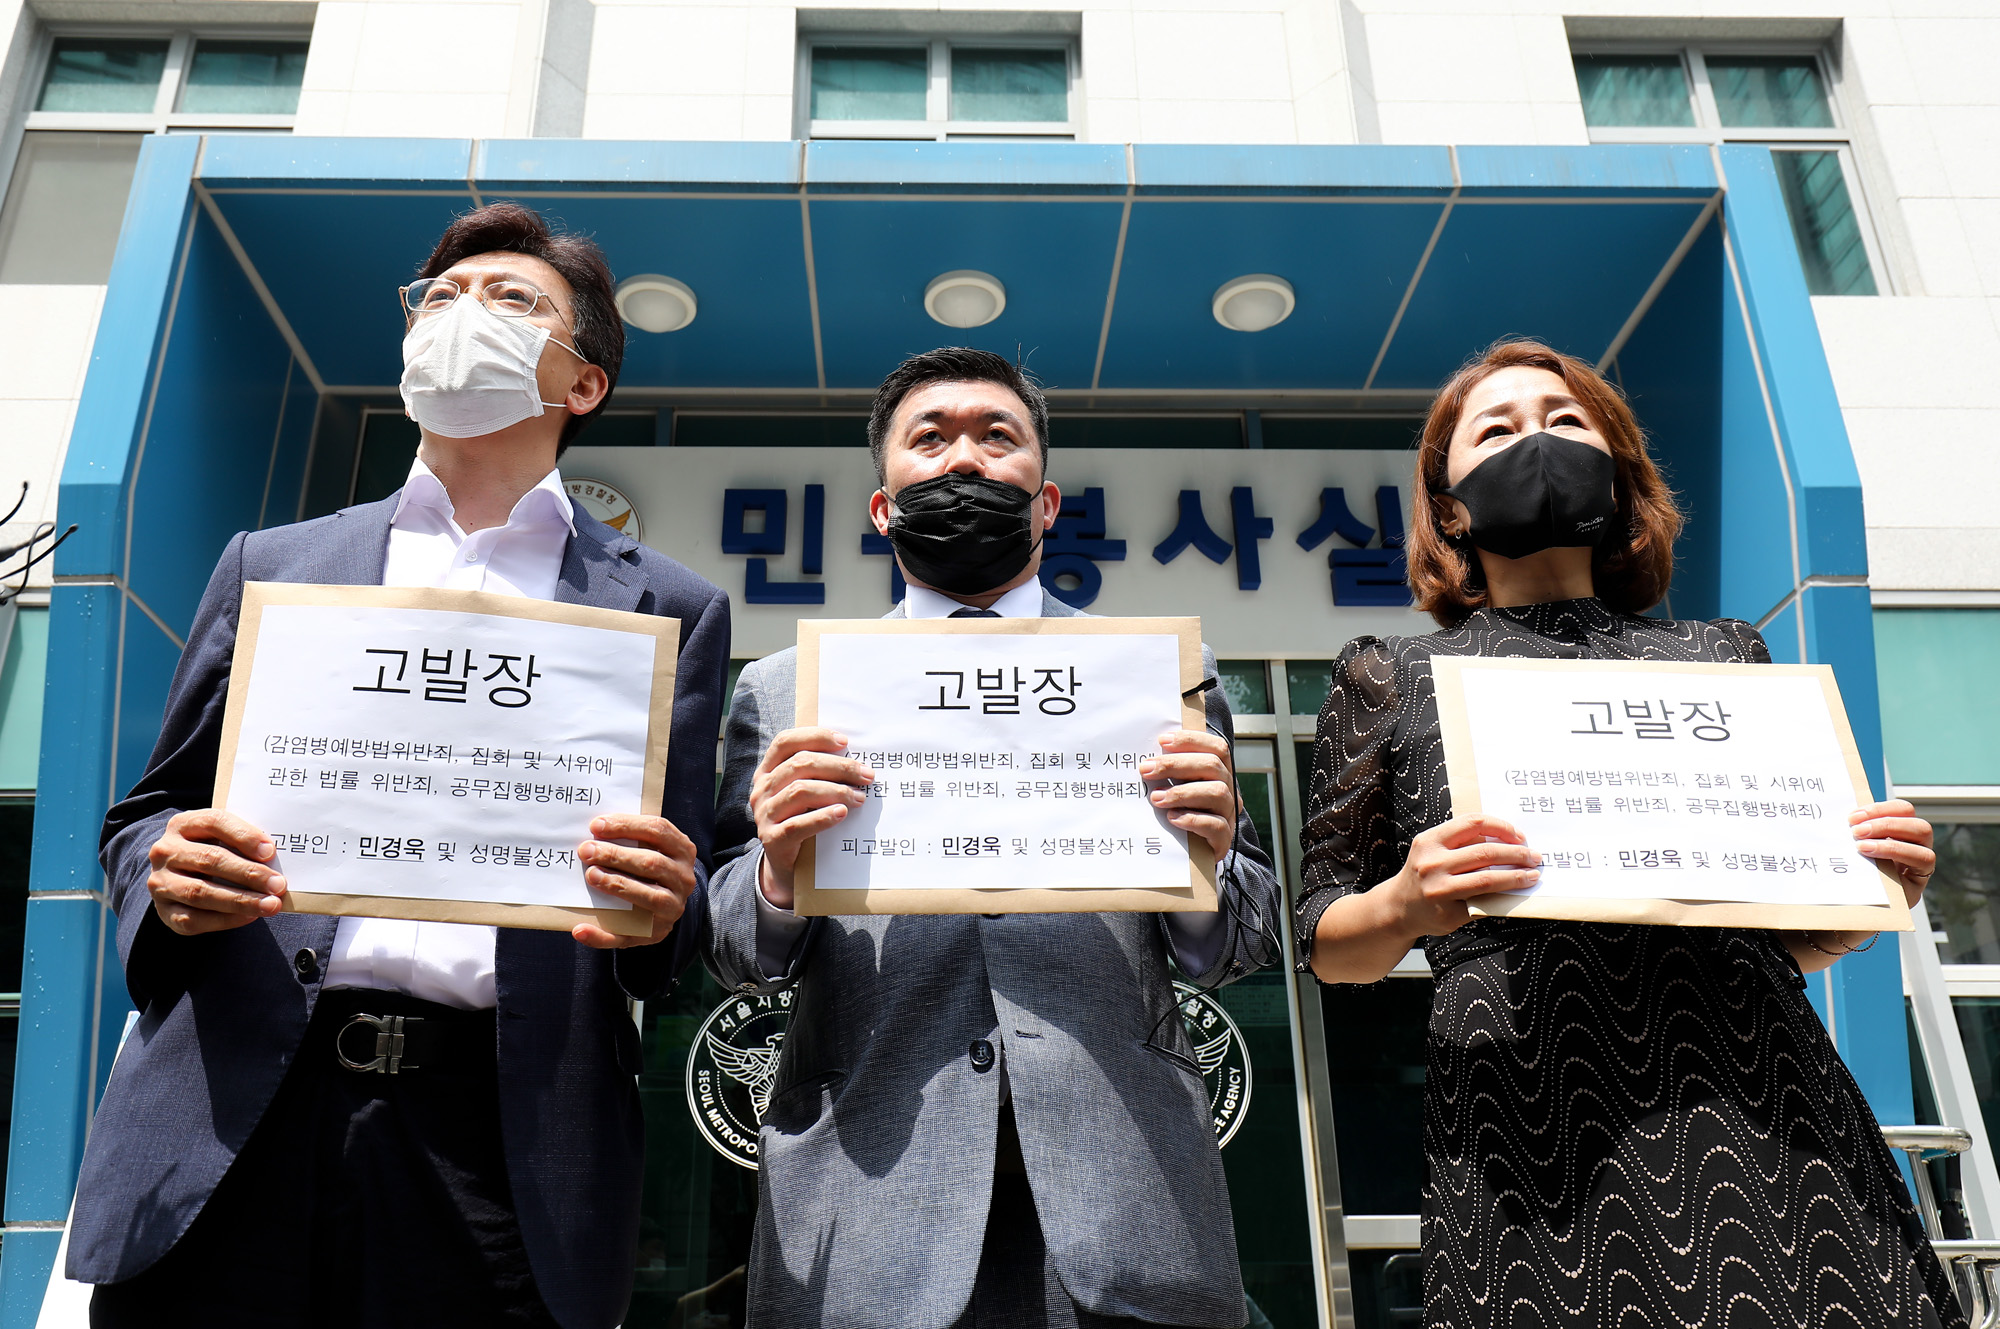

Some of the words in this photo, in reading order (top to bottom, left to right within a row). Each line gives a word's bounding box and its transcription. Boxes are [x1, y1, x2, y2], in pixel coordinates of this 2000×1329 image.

[565, 484, 617, 505] 방경찰청
[721, 484, 1414, 610] 민봉사실
[353, 647, 542, 709] 고발장
[918, 665, 1083, 717] 고발장
[1570, 699, 1732, 743] 고발장
[264, 734, 459, 763] (감염병예방법위반죄,
[471, 747, 511, 768] 집회
[523, 751, 542, 770] 및
[553, 753, 613, 777] 시위에
[1030, 752, 1065, 770] 집회
[1075, 752, 1092, 770] 및
[268, 767, 308, 788] 관한
[320, 769, 360, 790] 법률
[371, 772, 438, 795] 위반죄,
[450, 777, 602, 806] 공무집행방해죄)
[900, 780, 936, 798] 법률
[945, 780, 1005, 798] 위반죄,
[1015, 781, 1149, 799] 공무집행방해죄)
[1694, 773, 1731, 789] 집회
[1740, 774, 1759, 791] 및
[1770, 776, 1825, 793] 시위에
[1519, 796, 1555, 813] 관한
[1565, 796, 1603, 814] 법률
[1685, 797, 1823, 820] 공무집행방해죄)
[268, 833, 330, 855] 고발인
[357, 836, 427, 860] 민경욱
[437, 841, 457, 862] 및
[469, 843, 576, 869] 성명불상자
[840, 837, 916, 856] 피고발인
[942, 836, 1002, 857] 민경욱
[1011, 838, 1028, 856] 및
[1040, 838, 1134, 856] 성명불상자
[1144, 838, 1163, 856] 등
[1537, 851, 1592, 868] 고발인
[1618, 849, 1683, 868] 민경욱
[1691, 851, 1711, 868] 및
[1721, 852, 1818, 874] 성명불상자
[1829, 857, 1849, 874] 등
[720, 990, 793, 1032] 서울지방
[698, 1070, 714, 1109] SEOUL
[706, 1108, 760, 1156] METROPO
[1220, 1067, 1241, 1120] AGENCY
